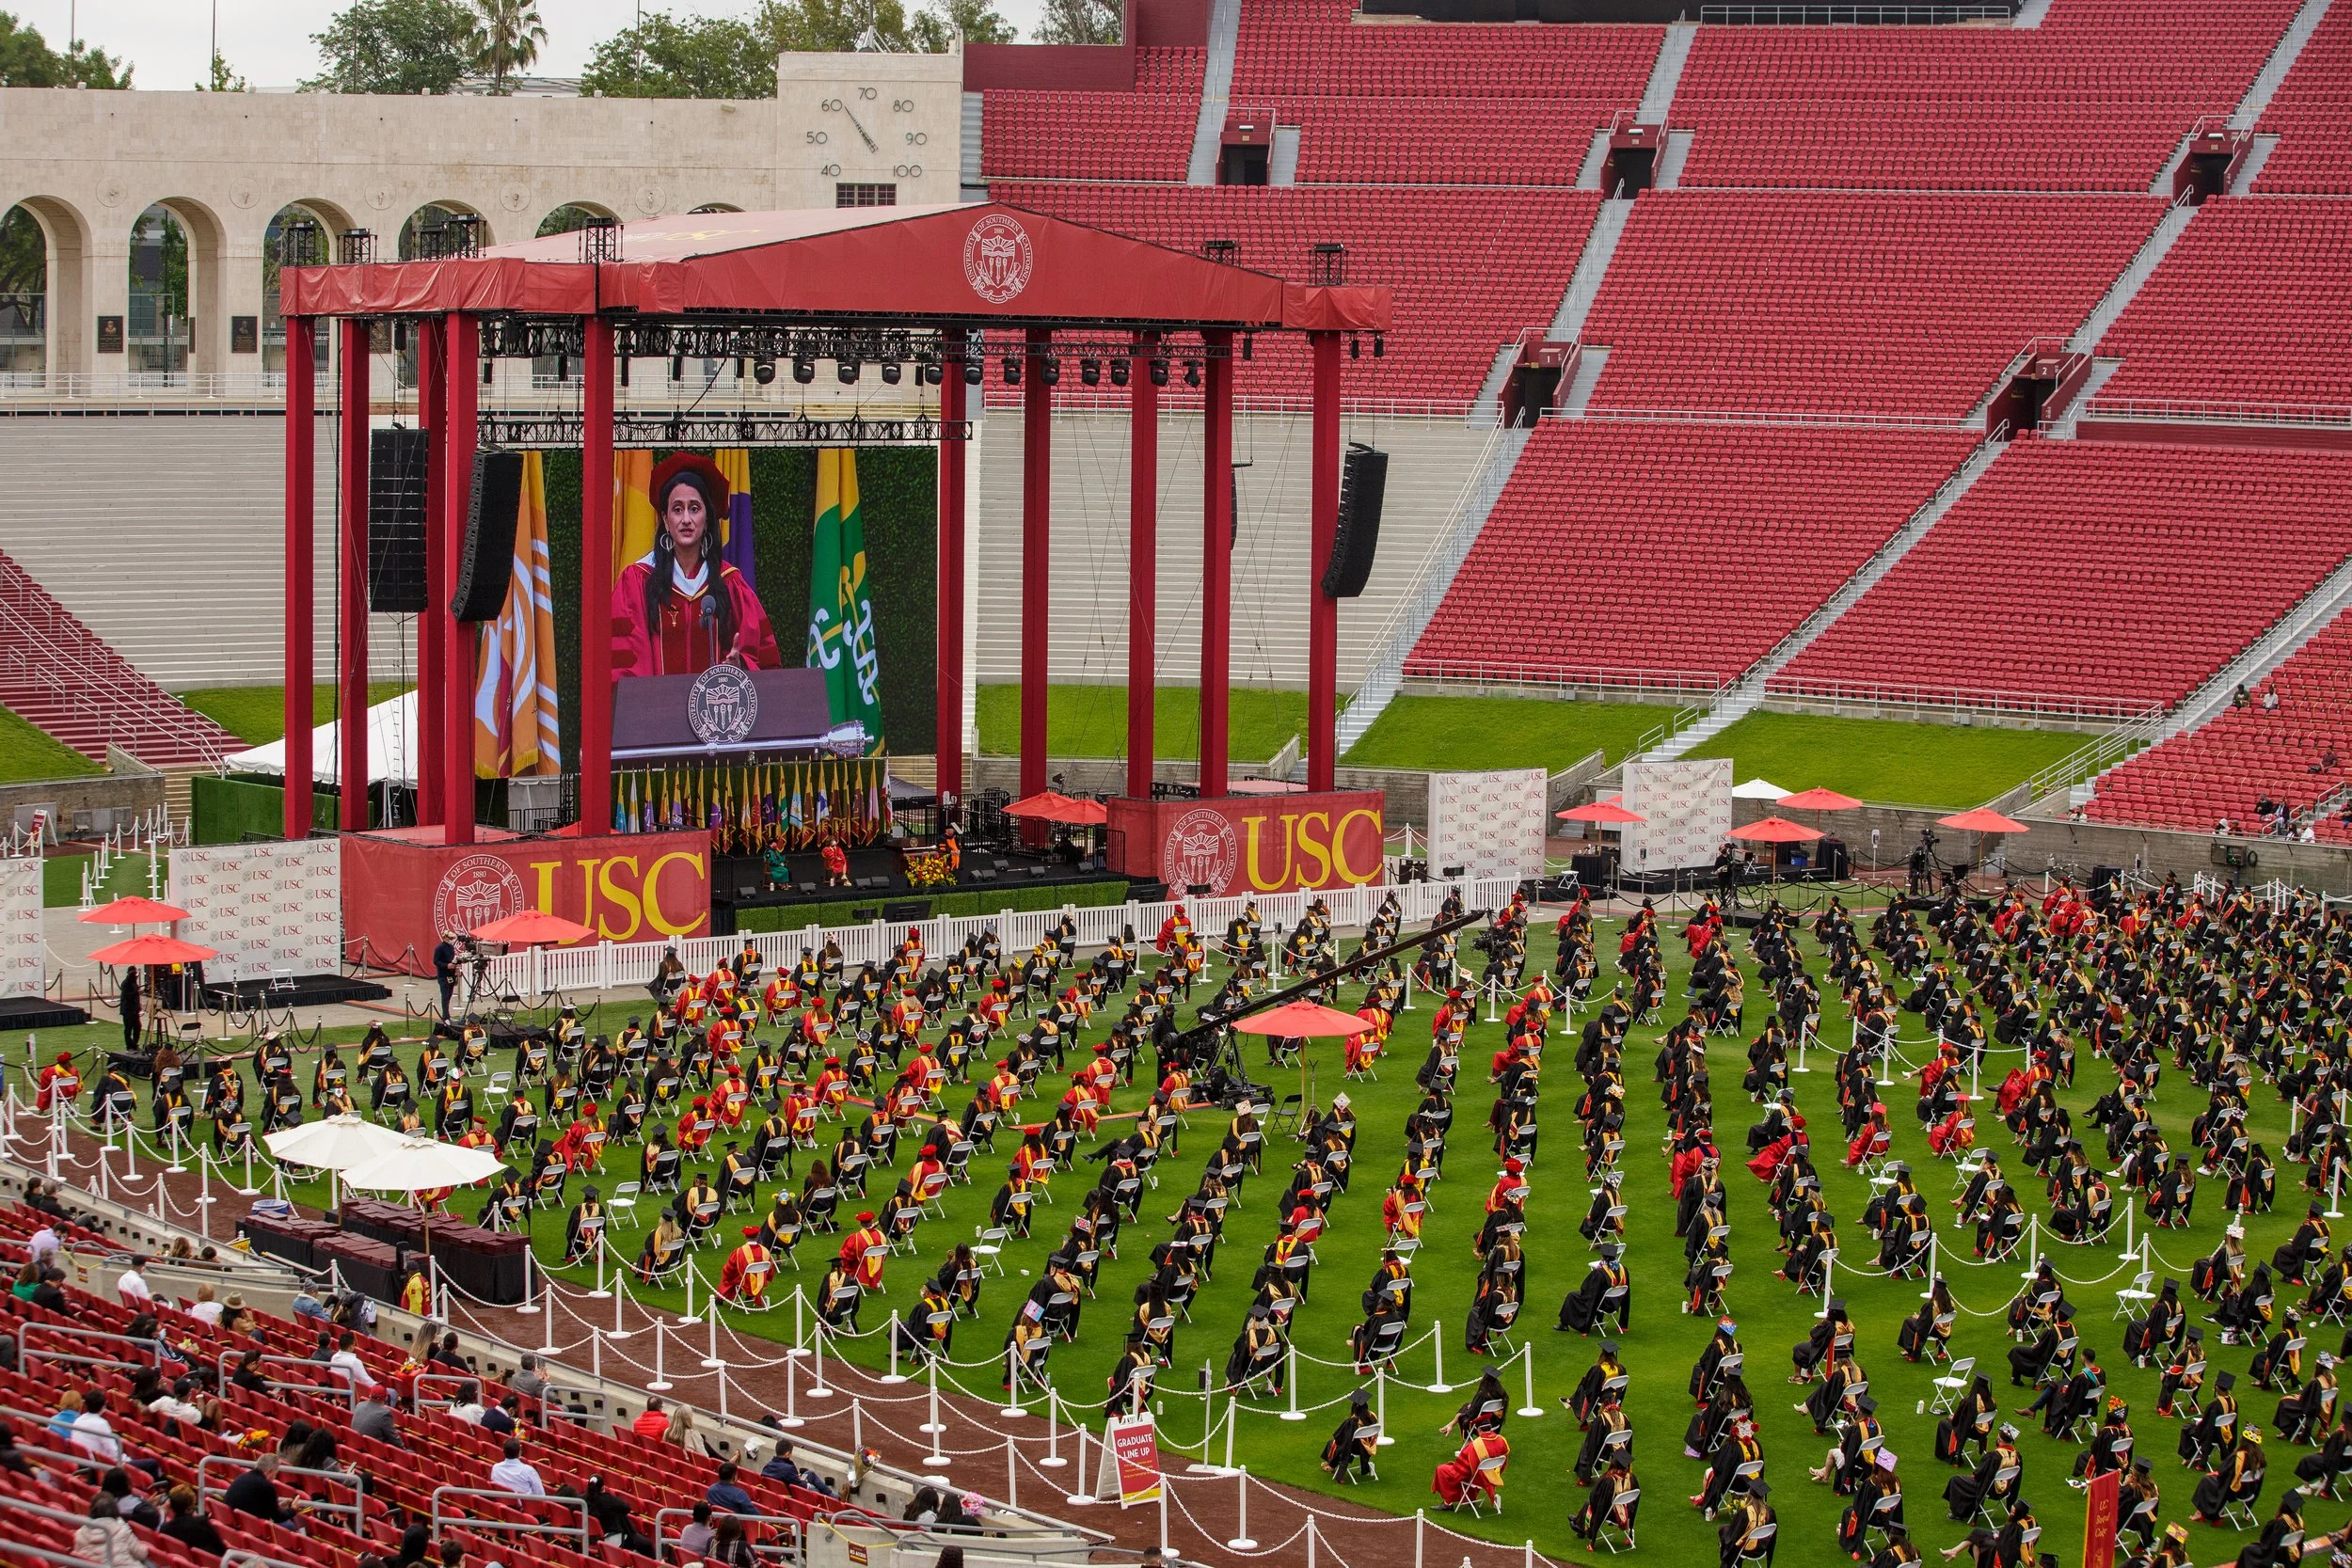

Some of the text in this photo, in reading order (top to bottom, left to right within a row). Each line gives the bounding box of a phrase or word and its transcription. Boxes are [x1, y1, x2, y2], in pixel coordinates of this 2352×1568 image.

[858, 87, 877, 100] 70
[821, 99, 842, 111] 60
[893, 100, 914, 112] 80
[806, 132, 827, 144] 50
[906, 133, 927, 145] 90
[821, 165, 840, 176] 40
[894, 165, 922, 177] 100
[966, 235, 976, 281] UNIVERSITY
[986, 216, 1020, 231] SOUTHERN
[1020, 238, 1030, 282] CALIFORNIA
[690, 667, 755, 729] UNIVERSITY OF SOUTHERN CALIFORNIA
[1509, 783, 1522, 791] USC
[1698, 790, 1709, 799] USC
[1696, 808, 1708, 816] USC
[1508, 820, 1519, 829] USC
[1445, 833, 1456, 842] USC
[254, 847, 274, 857] USC
[316, 843, 336, 852] USC
[1167, 812, 1235, 884] UNIVERSITY OF SOUTHERN CALIFORNIA
[1242, 810, 1382, 891] USC
[191, 851, 210, 862] USC
[286, 857, 304, 866] USC
[1445, 852, 1455, 861] USC
[18, 863, 38, 872] USC
[222, 862, 242, 871] USC
[316, 866, 336, 876] USC
[452, 866, 460, 877] OF
[464, 858, 507, 872] SOUTHERN
[190, 875, 209, 884] USC
[253, 870, 272, 879] USC
[221, 884, 240, 894] USC
[284, 879, 304, 889] USC
[18, 885, 39, 895] USC
[315, 889, 336, 898] USC
[190, 897, 208, 908] USC
[252, 894, 271, 903] USC
[530, 852, 707, 944] USC
[220, 908, 239, 917] USC
[283, 903, 303, 913] USC
[18, 910, 39, 919] USC
[315, 912, 336, 922] USC
[191, 921, 208, 931] USC
[251, 916, 270, 926] USC
[220, 930, 239, 940] USC
[283, 926, 302, 935] USC
[18, 933, 39, 943] USC
[315, 935, 336, 944] USC
[251, 940, 270, 949] USC
[220, 953, 239, 963] USC
[283, 948, 303, 958] USC
[18, 958, 40, 967] USC
[252, 962, 271, 972] USC
[316, 958, 336, 967] USC
[19, 981, 40, 991] USC
[1118, 1433, 1152, 1447] GRADUATE
[1123, 1448, 1150, 1459] LINE UP
